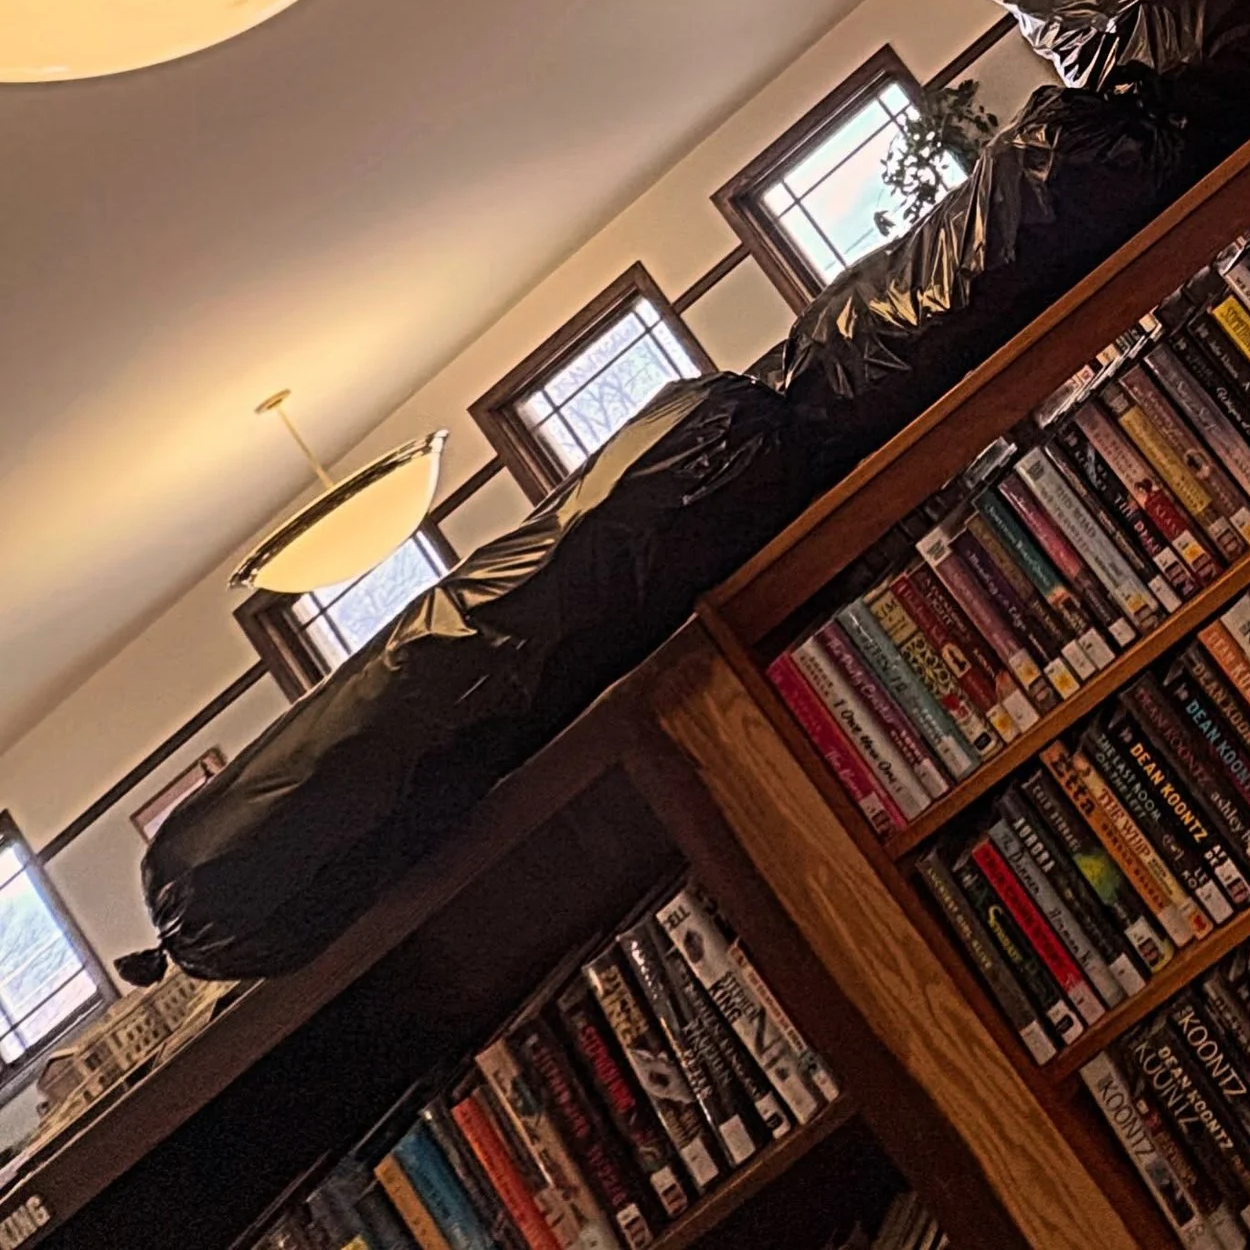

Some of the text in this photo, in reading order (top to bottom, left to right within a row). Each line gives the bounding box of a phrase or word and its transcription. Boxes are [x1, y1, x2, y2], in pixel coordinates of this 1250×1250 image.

[1233, 276, 1247, 291] WE
[839, 707, 863, 735] Owe
[1183, 697, 1222, 744] DEAN
[1050, 751, 1102, 818] Etta
[1095, 734, 1164, 822] THE LAST ROOM
[1163, 726, 1214, 787] KOONTZ
[1127, 742, 1209, 844] DEAN KOONTZ
[1207, 787, 1247, 834] ashley
[1006, 849, 1044, 896] Dinner
[1009, 816, 1058, 873] AURORA
[923, 866, 993, 969] LUCKIEST ALIVE
[706, 981, 743, 1024] KING
[718, 969, 762, 1022] STEPHEN
[1173, 1009, 1249, 1105] KOONTZ
[1096, 1079, 1156, 1163] KOONTZ
[1156, 1045, 1234, 1154] DEAN KOONTZ
